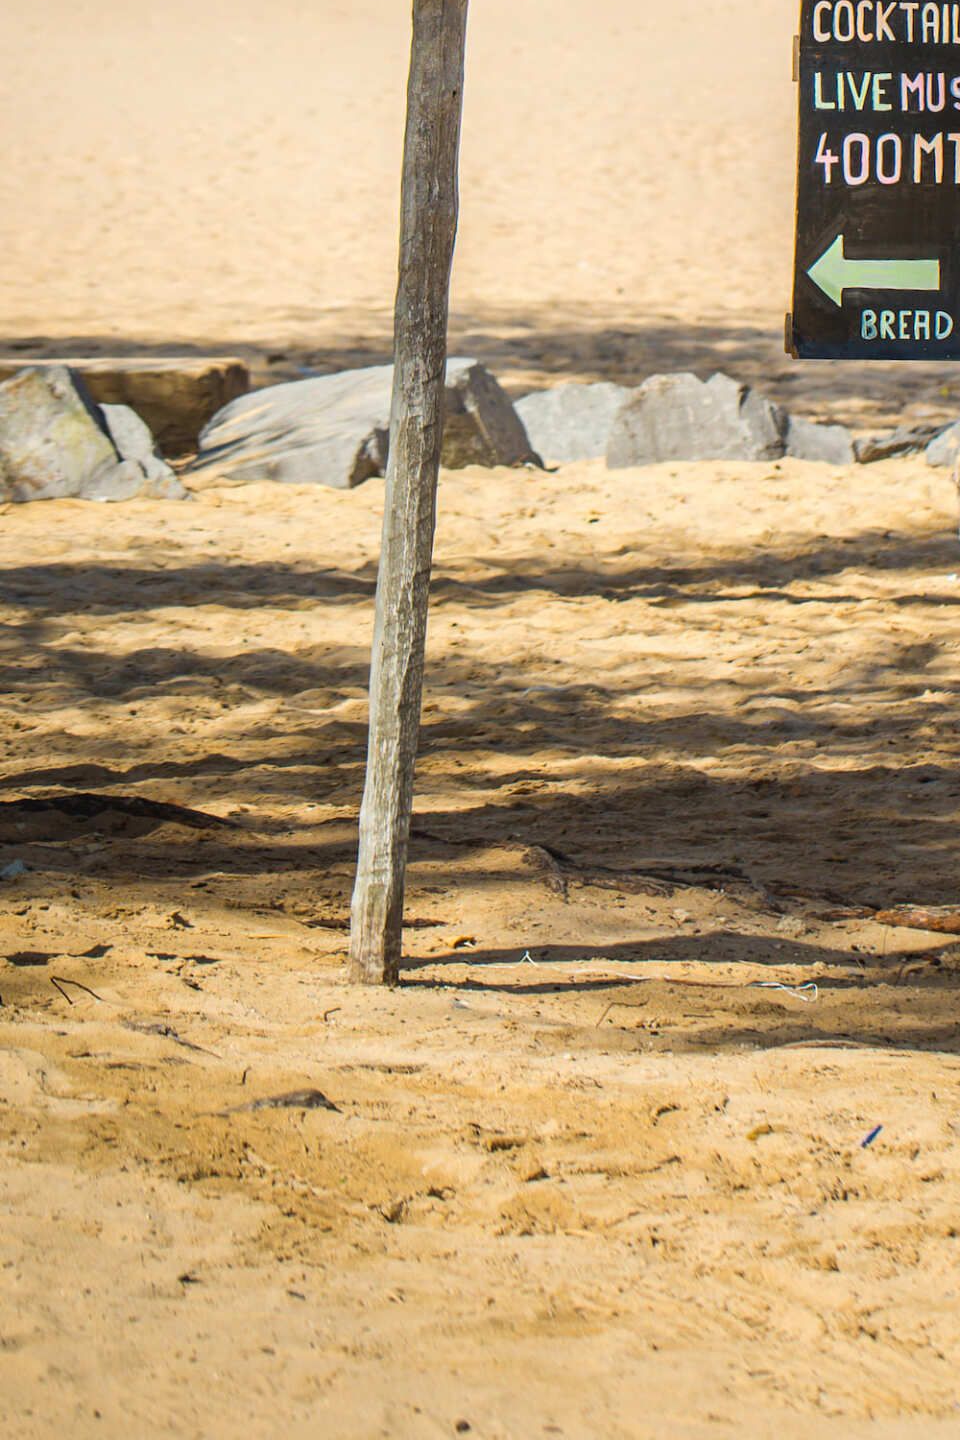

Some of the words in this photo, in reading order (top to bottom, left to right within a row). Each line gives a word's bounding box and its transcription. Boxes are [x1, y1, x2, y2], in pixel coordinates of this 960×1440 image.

[814, 71, 893, 111] LIVE
[815, 131, 902, 185] 400
[861, 309, 953, 340] BREAD
